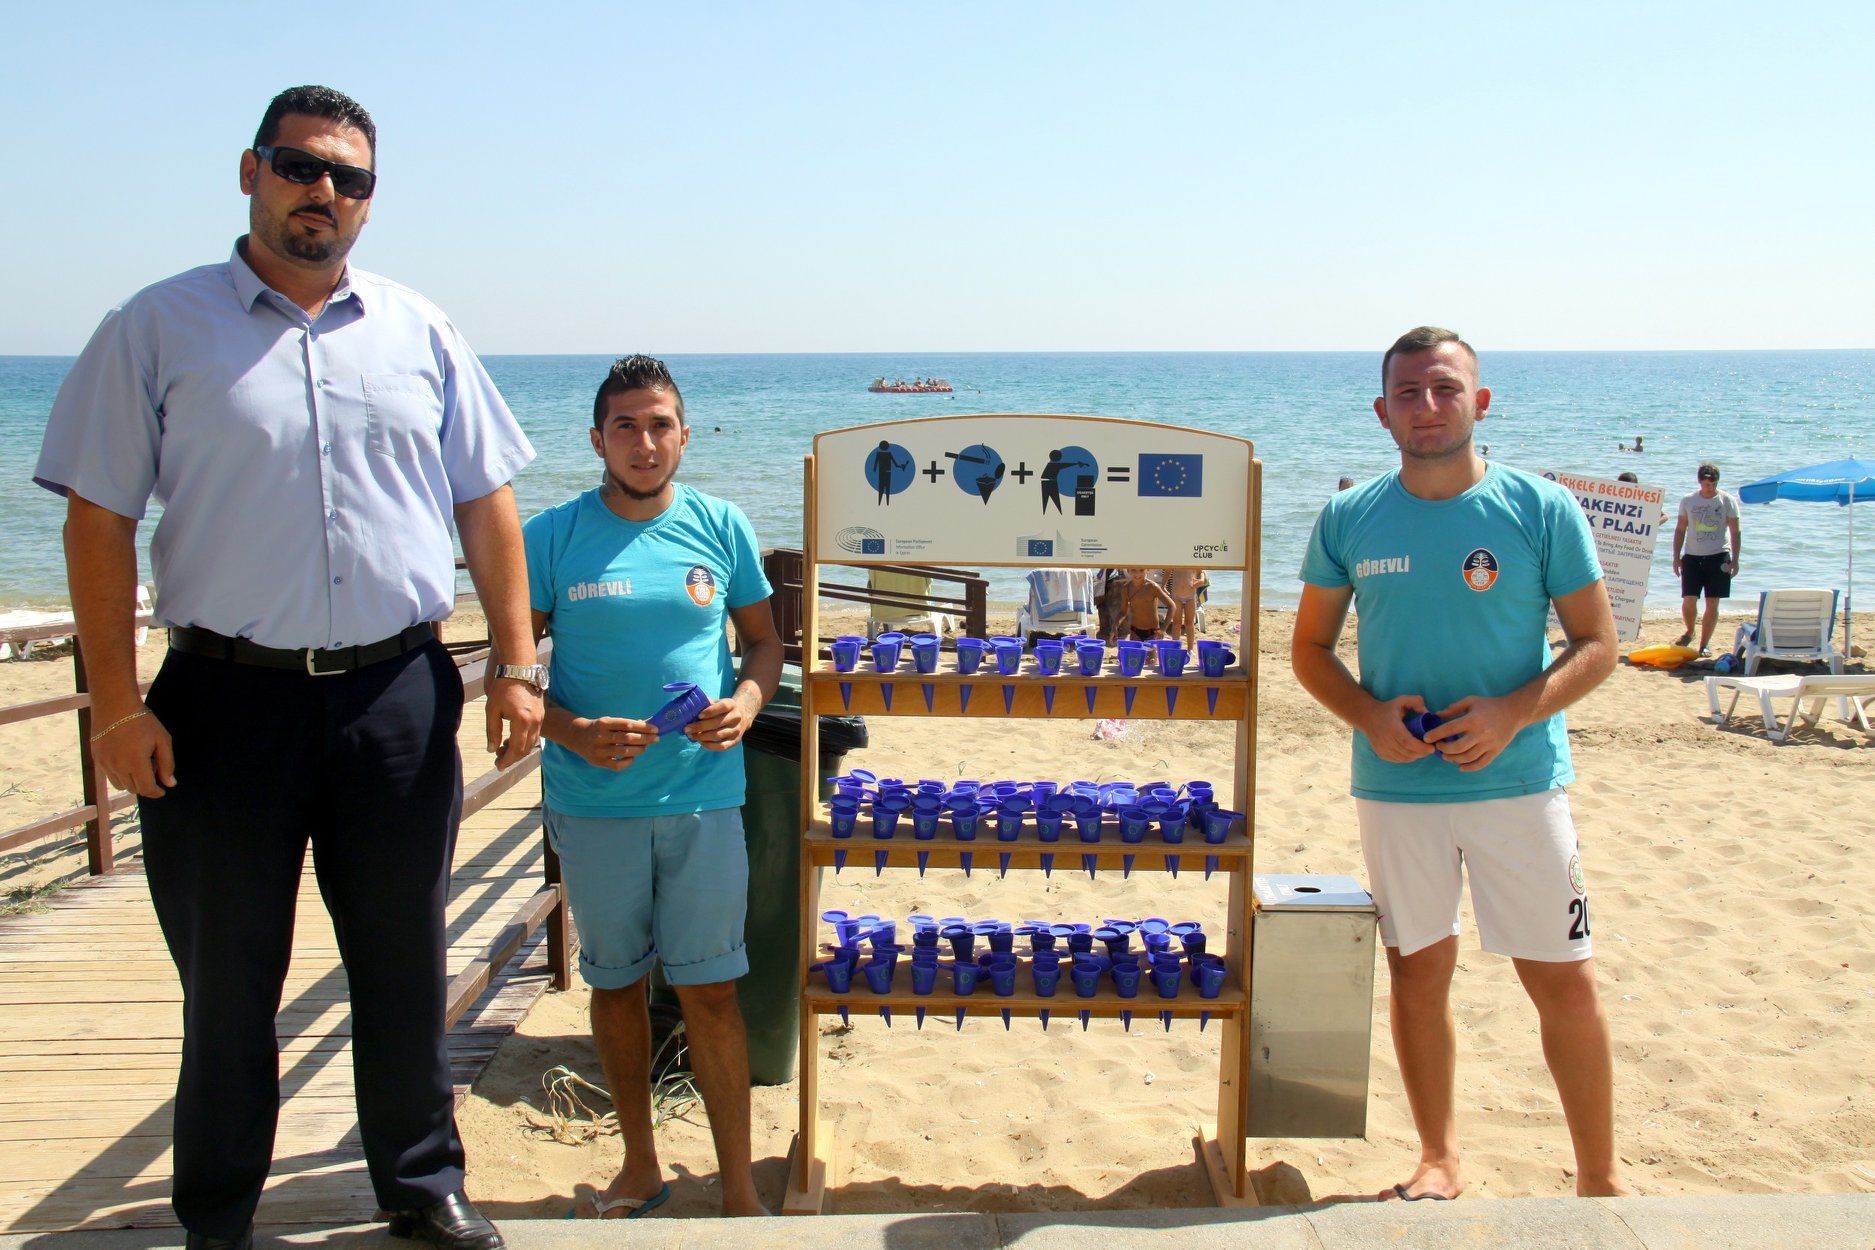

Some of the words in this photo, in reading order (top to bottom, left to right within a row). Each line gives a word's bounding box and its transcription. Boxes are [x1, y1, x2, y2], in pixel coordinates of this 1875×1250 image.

[1559, 474, 1596, 493] İSKELE
[1598, 482, 1662, 504] BELEDİYESİ
[1576, 496, 1643, 519] AKENZi
[1603, 517, 1652, 537] PLAJI
[1356, 554, 1410, 578] GÖREVLİ
[568, 577, 632, 602] GÖREVLİ
